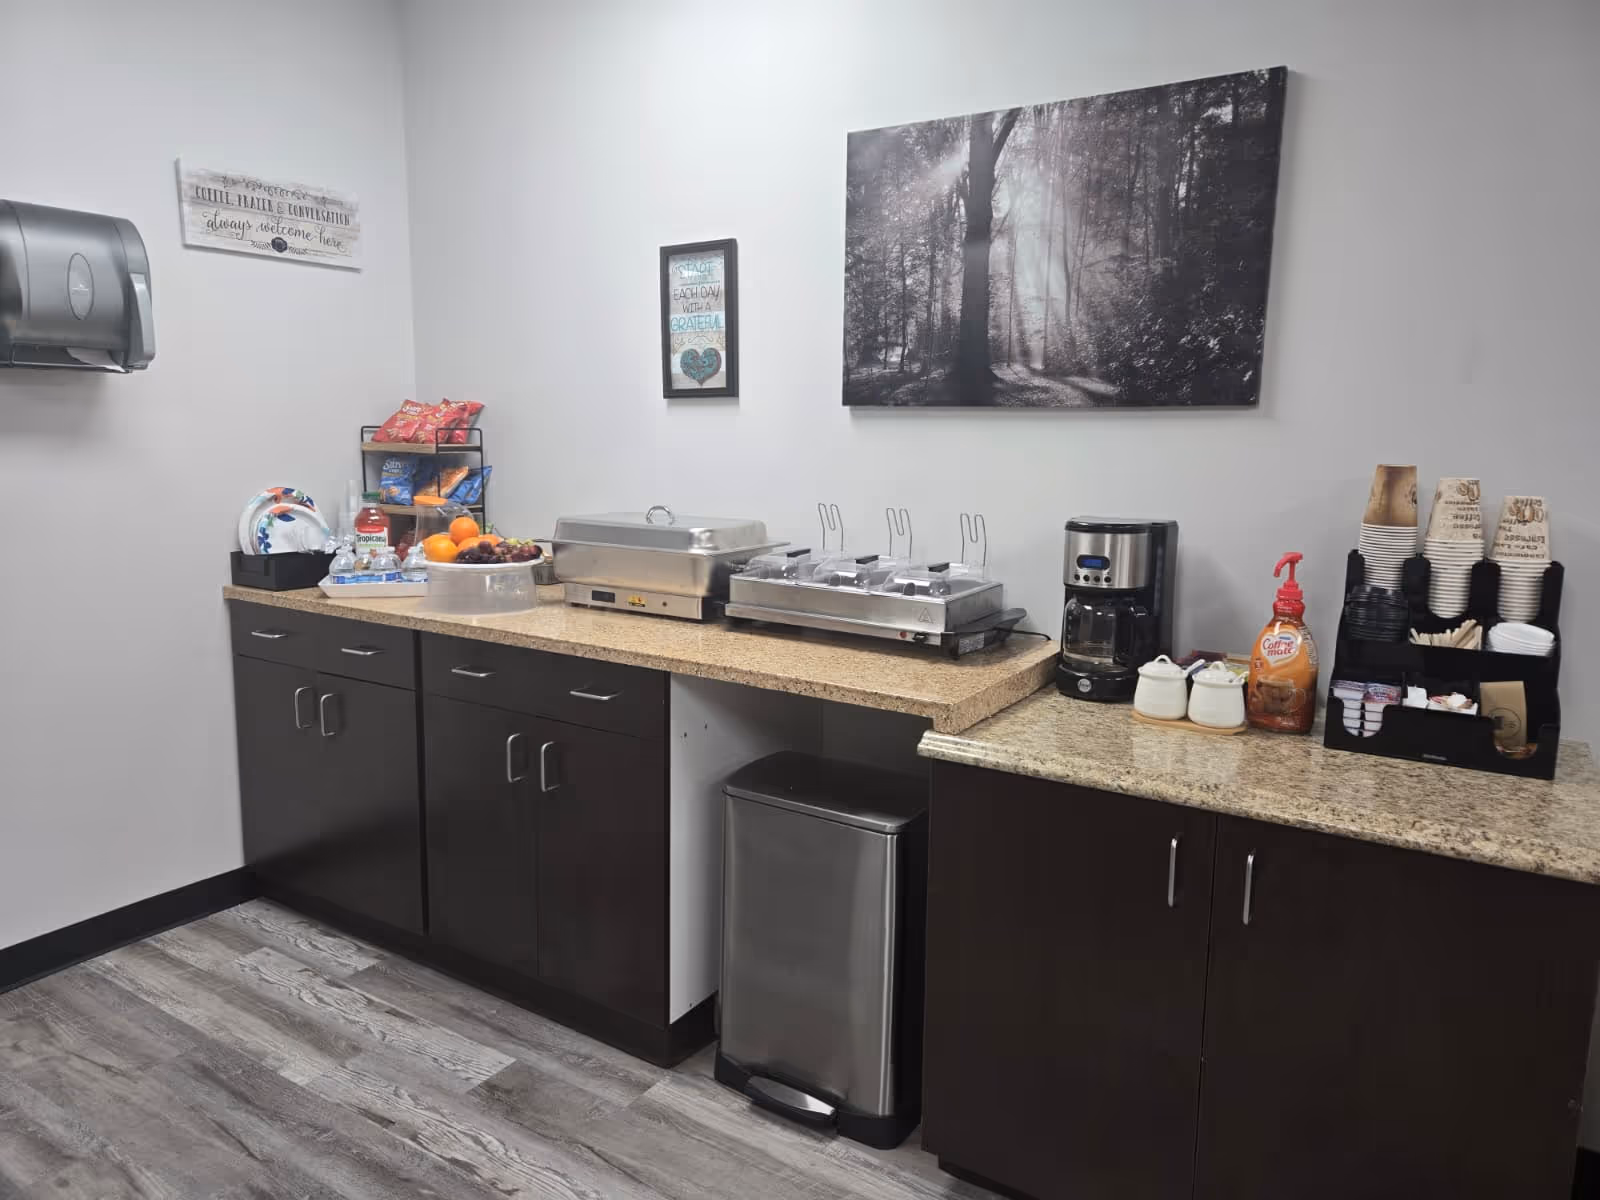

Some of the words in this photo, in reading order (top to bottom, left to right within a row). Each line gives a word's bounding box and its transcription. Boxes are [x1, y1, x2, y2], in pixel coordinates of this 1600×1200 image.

[237, 193, 274, 213] PRAYER
[277, 201, 285, 215] &
[288, 203, 351, 226] CONVERSATION
[202, 209, 253, 241] always
[255, 216, 314, 241] welcome
[315, 224, 347, 254] here
[673, 286, 698, 301] EACH
[700, 284, 720, 301] DAY
[682, 302, 703, 313] WITH
[705, 301, 712, 311] A
[671, 313, 724, 332] GRATEFUL
[356, 534, 386, 544] Tropicana
[1263, 638, 1294, 650] Coffee
[1267, 648, 1293, 657] mate
